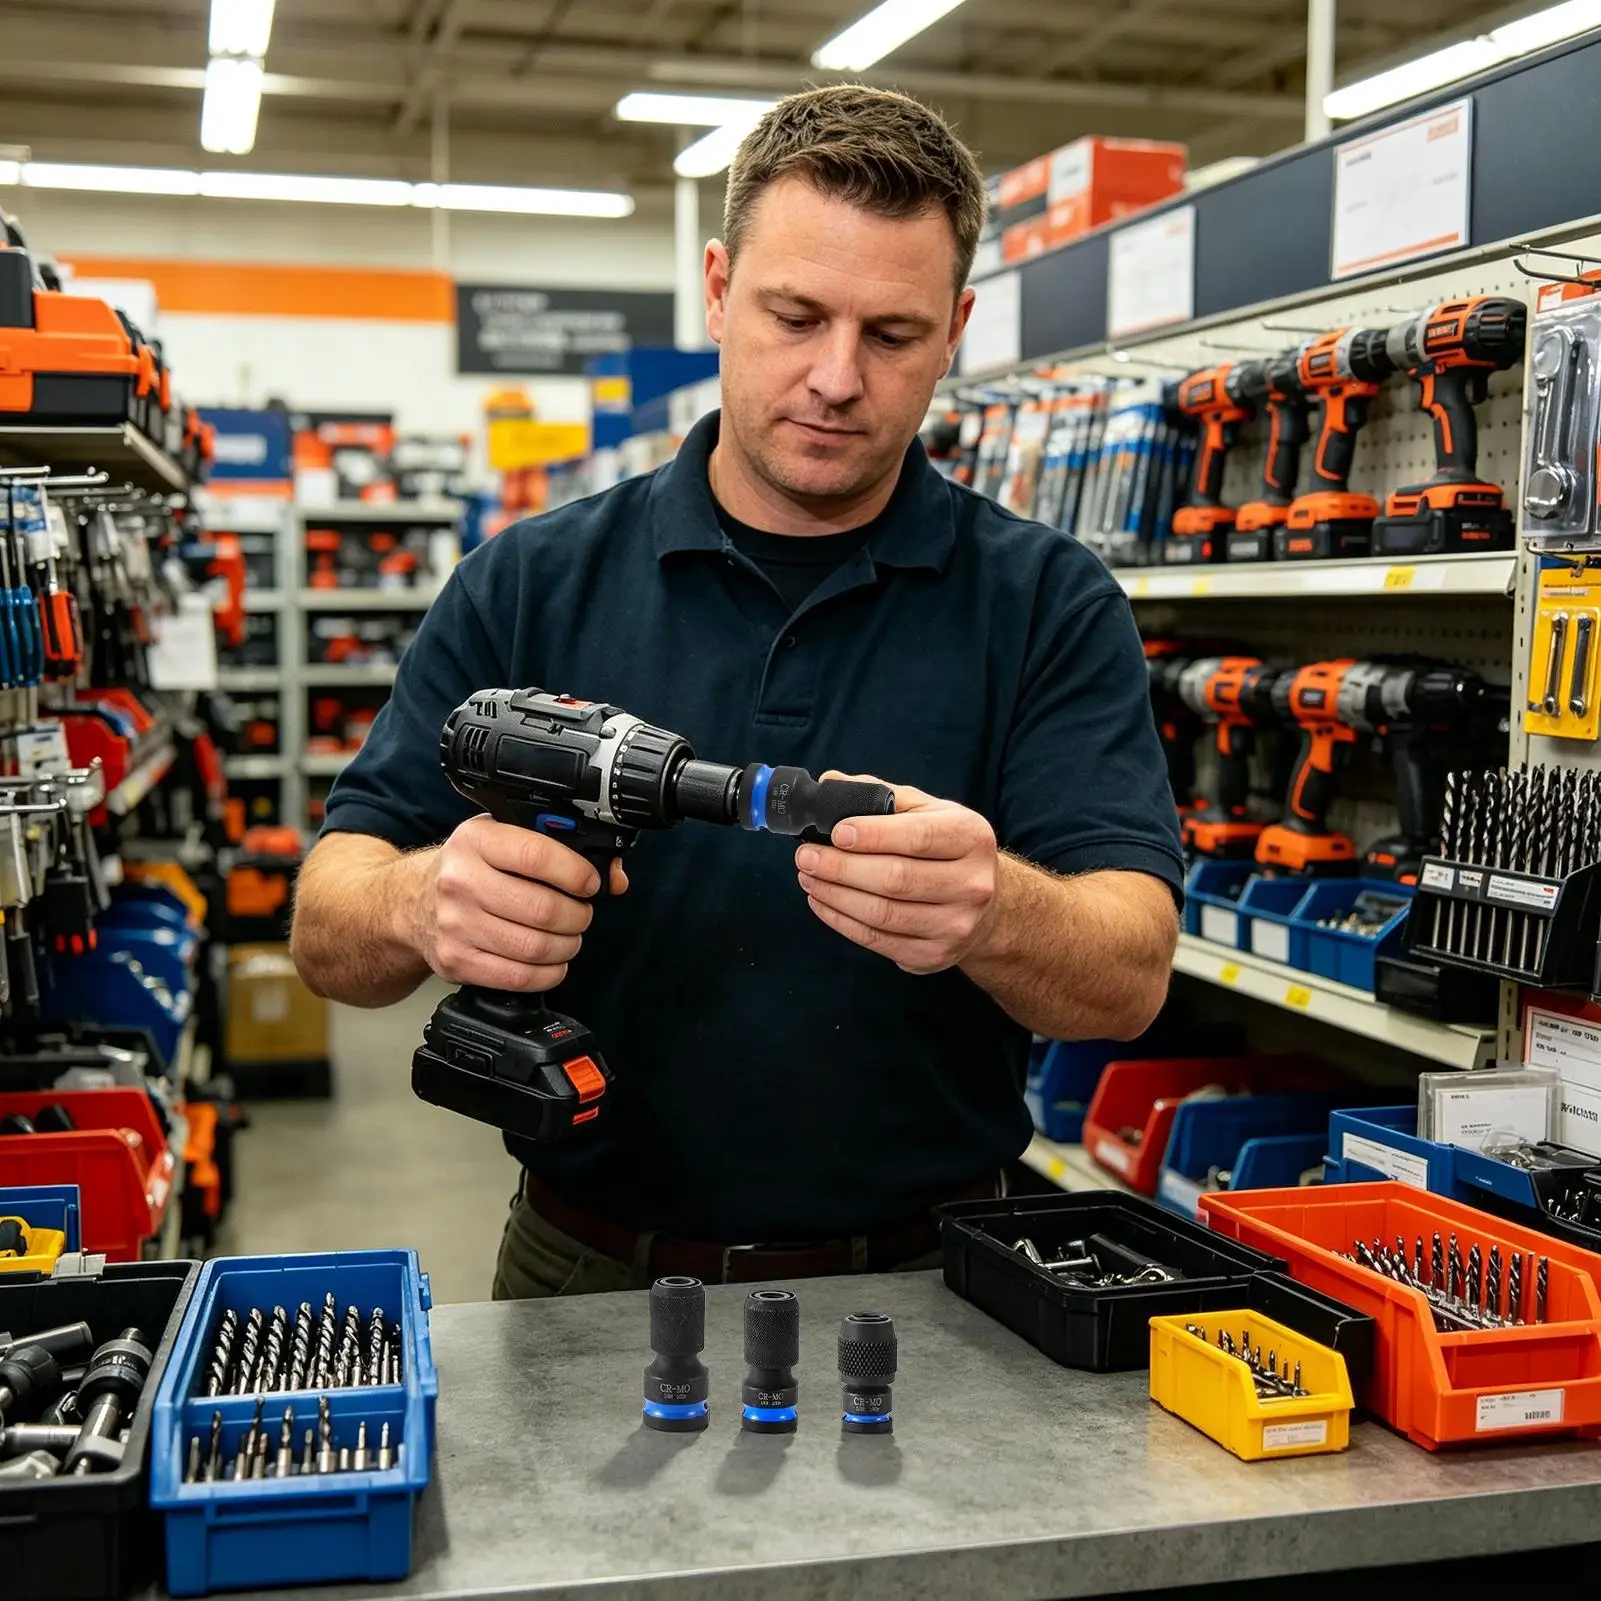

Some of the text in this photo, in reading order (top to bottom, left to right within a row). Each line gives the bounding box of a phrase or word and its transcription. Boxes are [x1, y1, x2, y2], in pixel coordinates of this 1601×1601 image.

[777, 783, 790, 815] CR-MO
[659, 1383, 691, 1394] CR-MO
[758, 1391, 784, 1401] CR-MO
[853, 1397, 882, 1406] CR-MO
